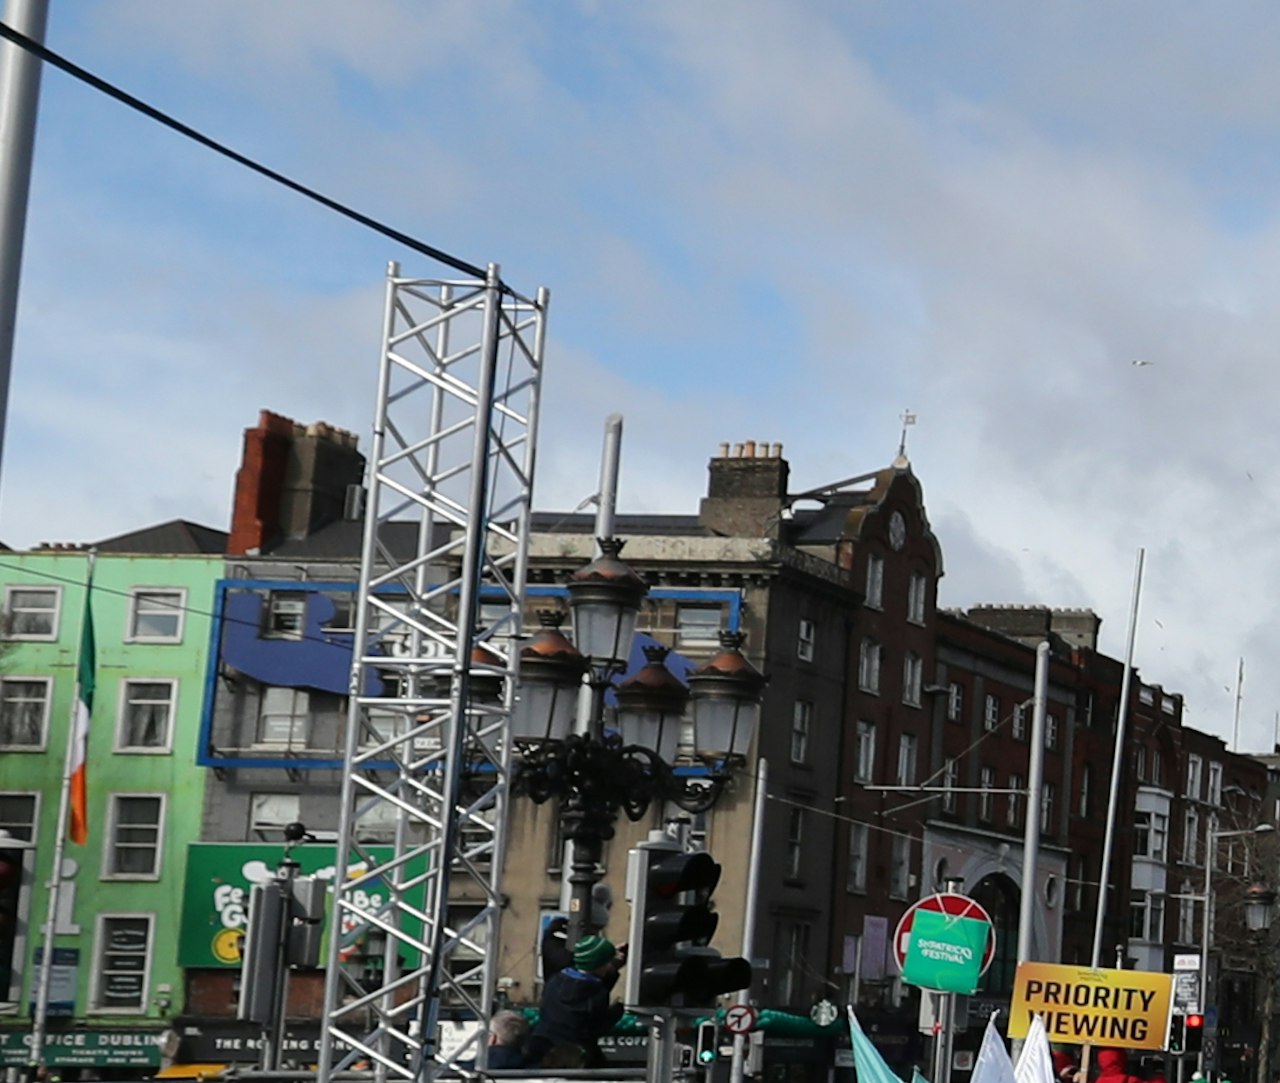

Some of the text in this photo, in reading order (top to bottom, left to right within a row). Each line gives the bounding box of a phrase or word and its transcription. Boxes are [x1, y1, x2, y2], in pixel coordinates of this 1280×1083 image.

[921, 948, 965, 964] FESTIVAL
[1025, 980, 1157, 1012] PRIORITY
[22, 1034, 86, 1046] OFICE
[97, 1034, 165, 1046] DUBLIN
[215, 1038, 241, 1049] THE
[246, 1038, 309, 1050] ROING
